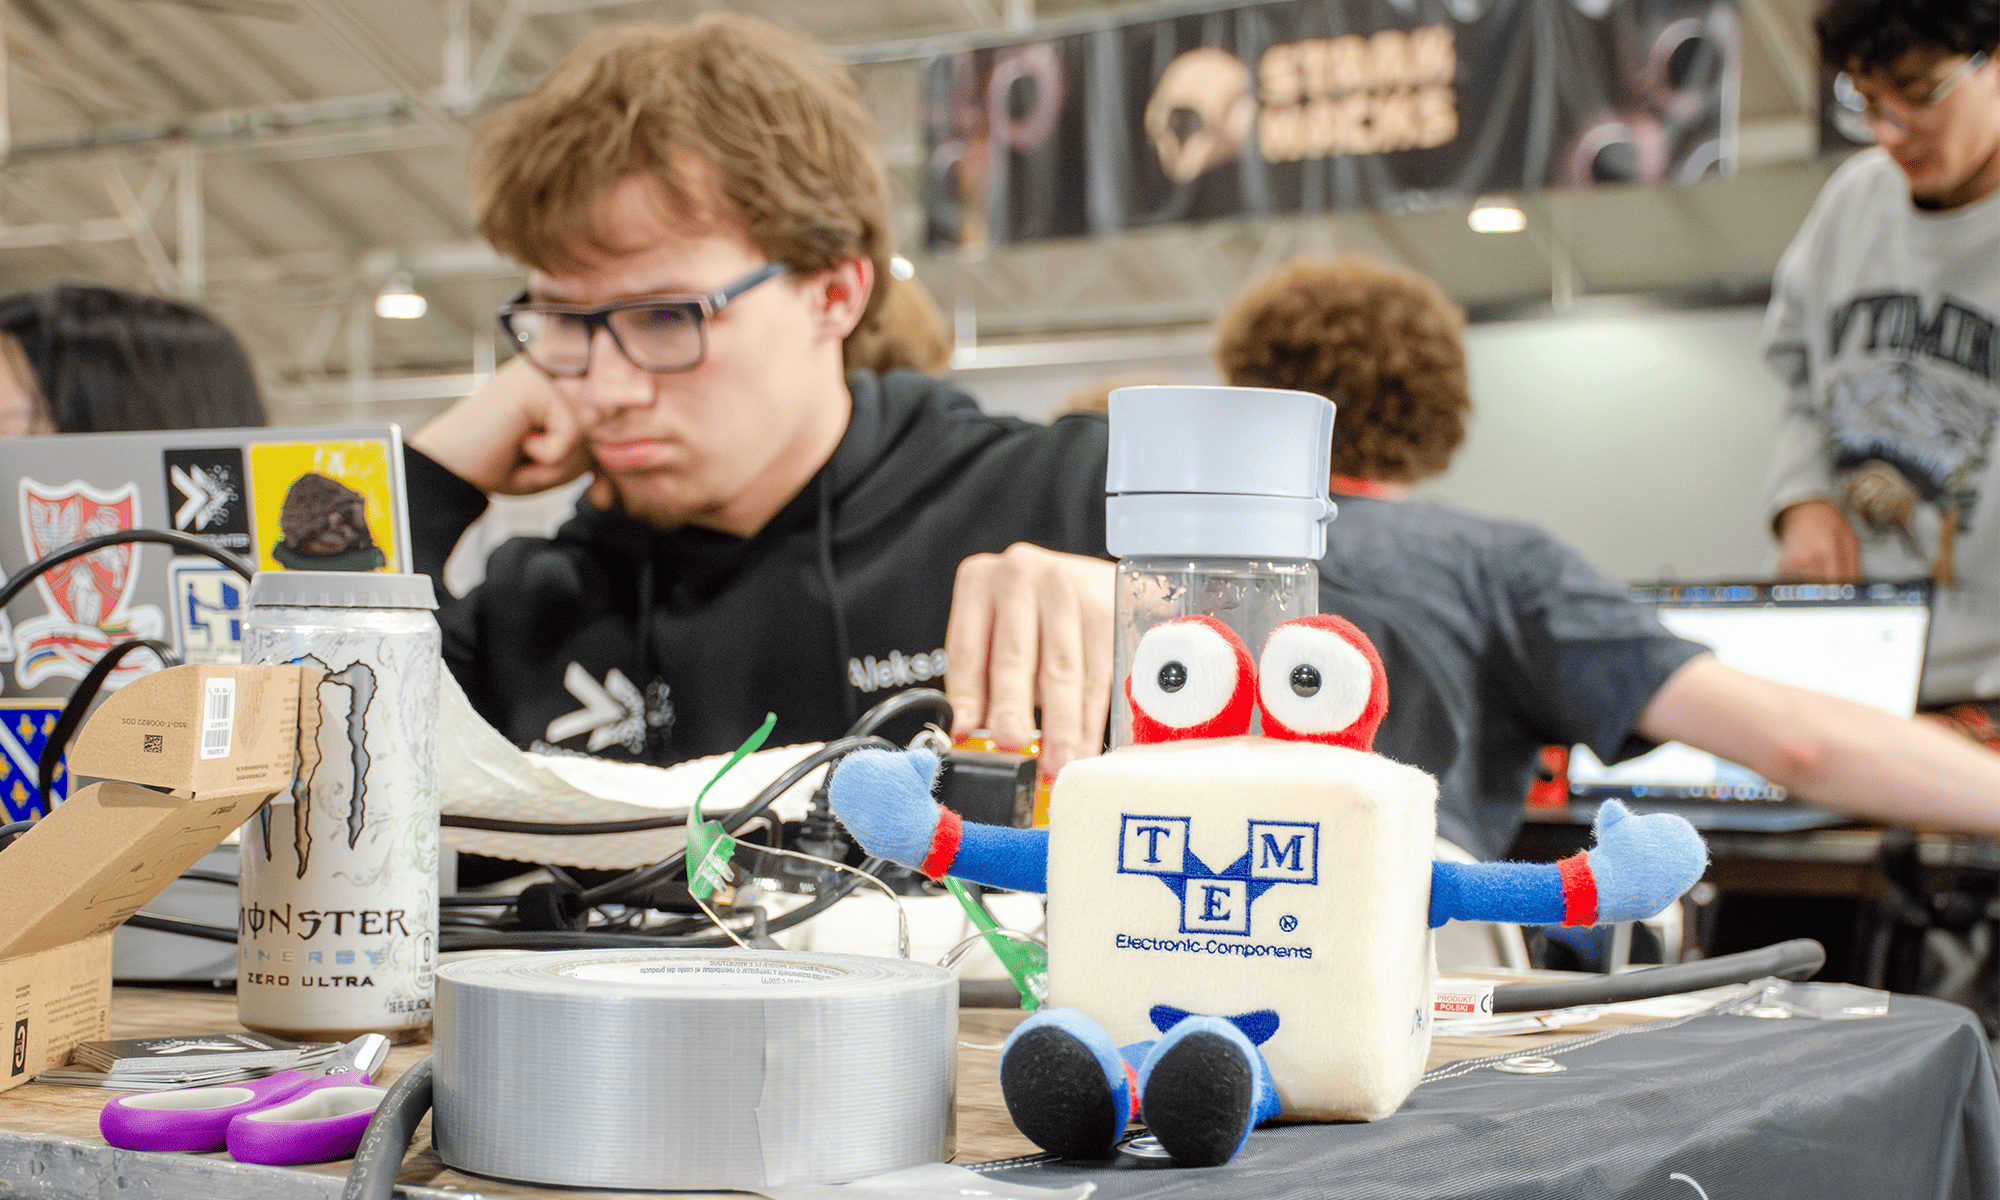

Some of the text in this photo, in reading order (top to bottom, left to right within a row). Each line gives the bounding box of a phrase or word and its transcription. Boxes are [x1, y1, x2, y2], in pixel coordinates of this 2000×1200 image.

[640, 966, 666, 975] producto
[666, 967, 676, 975] del
[677, 967, 694, 975] costo
[702, 967, 735, 975] reembolsar
[247, 973, 375, 987] ZERO ULTRA
[1436, 995, 1472, 1003] PRODUKT
[1440, 1003, 1468, 1012] POLSKI
